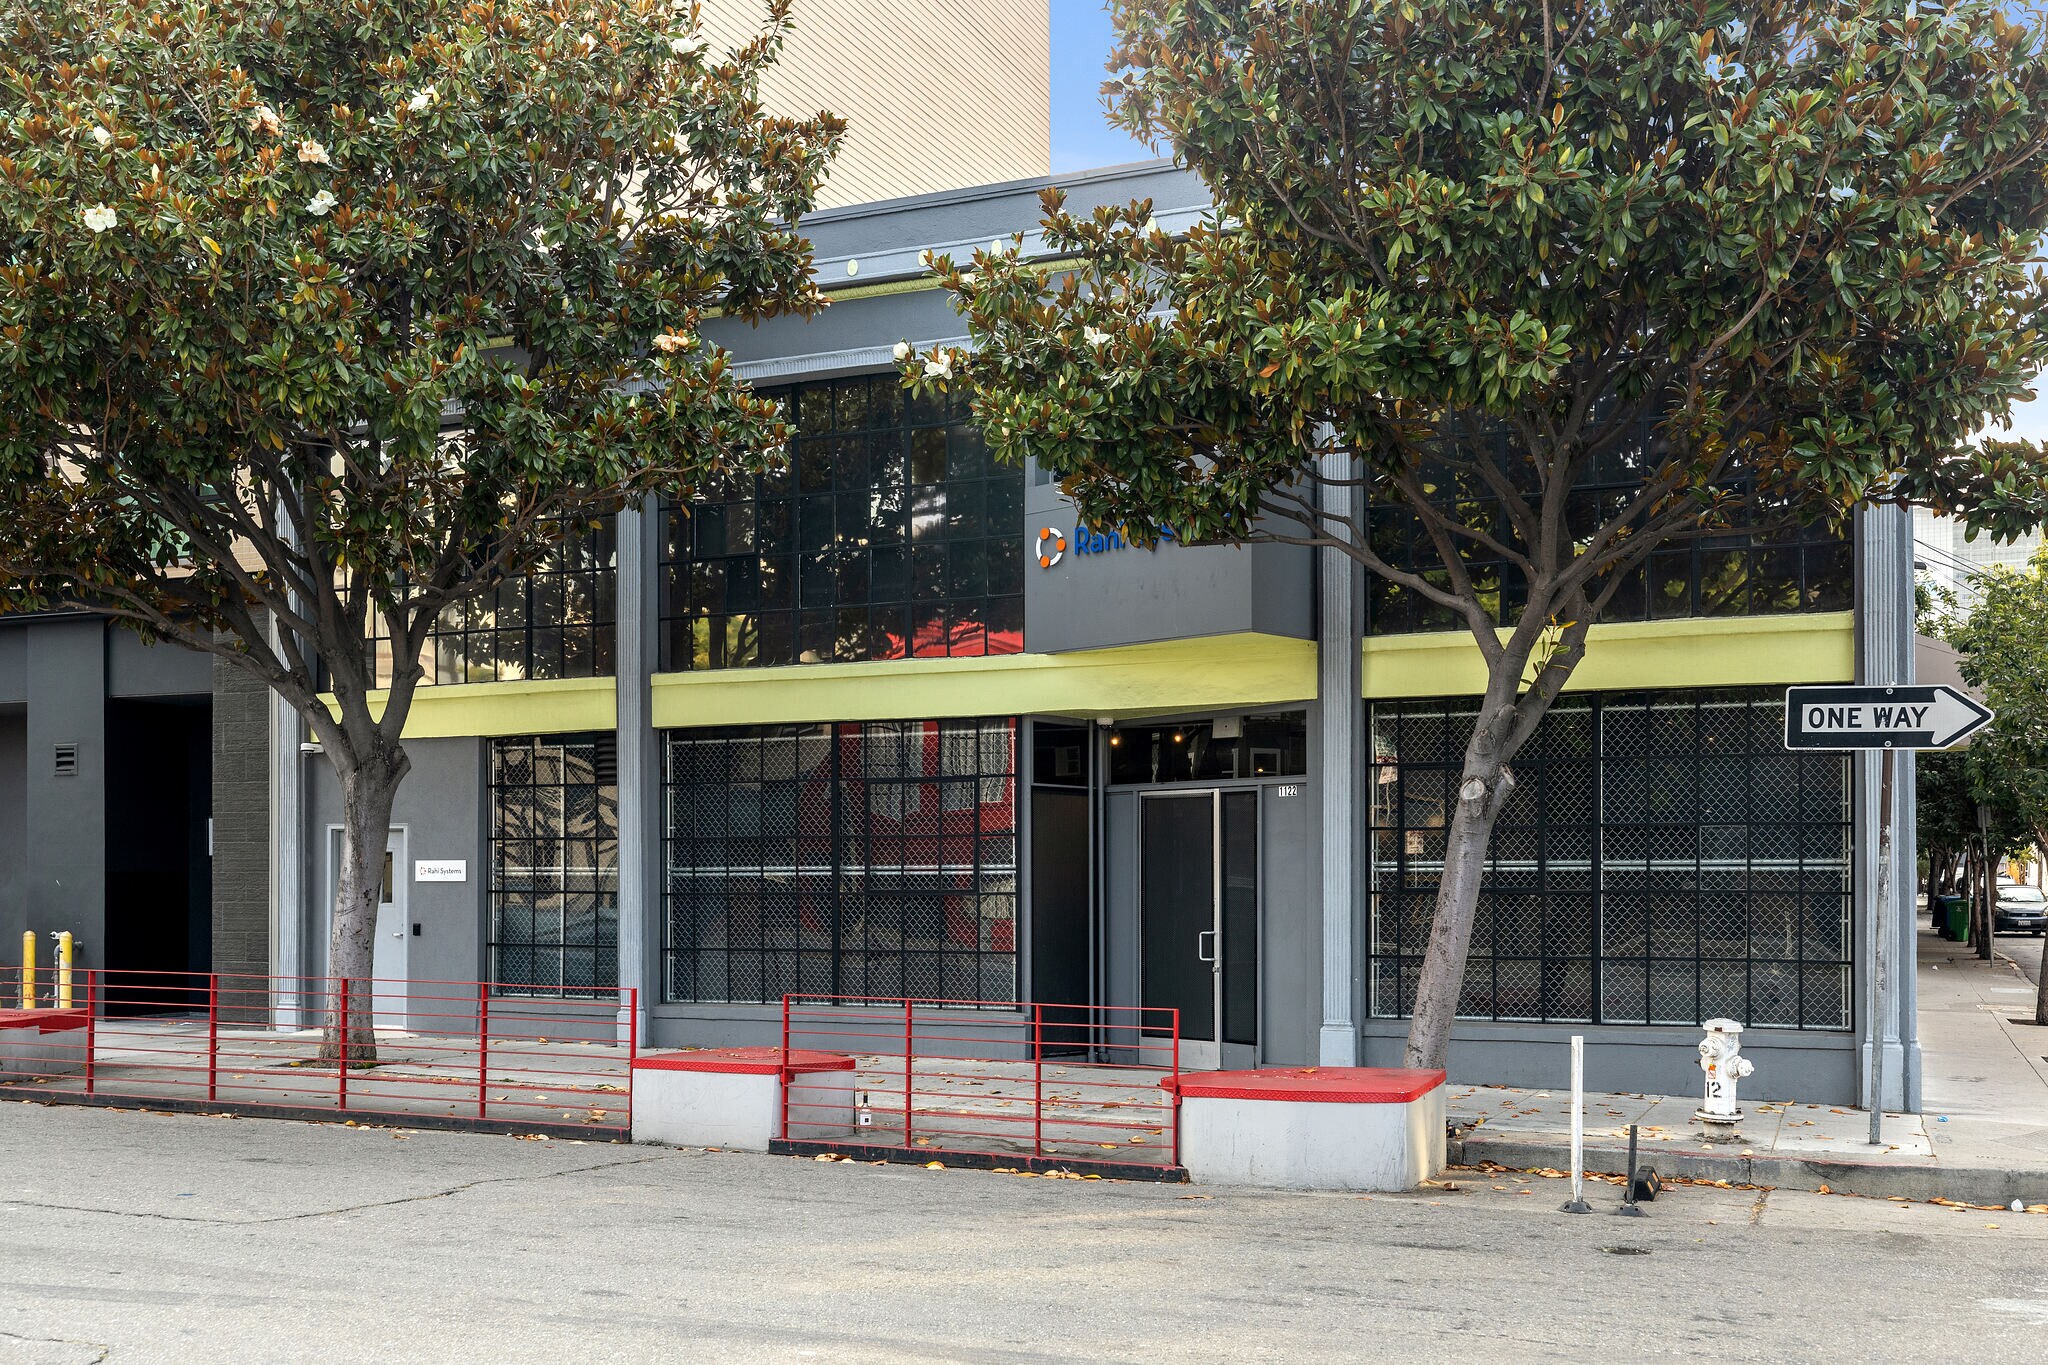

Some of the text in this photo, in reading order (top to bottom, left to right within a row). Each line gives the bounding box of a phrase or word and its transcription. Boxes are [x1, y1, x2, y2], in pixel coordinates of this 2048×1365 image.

[1808, 706, 1929, 729] ONE WAY
[1279, 786, 1297, 797] 1122
[427, 867, 462, 876] Rahi Systems
[1706, 1081, 1722, 1098] 12
